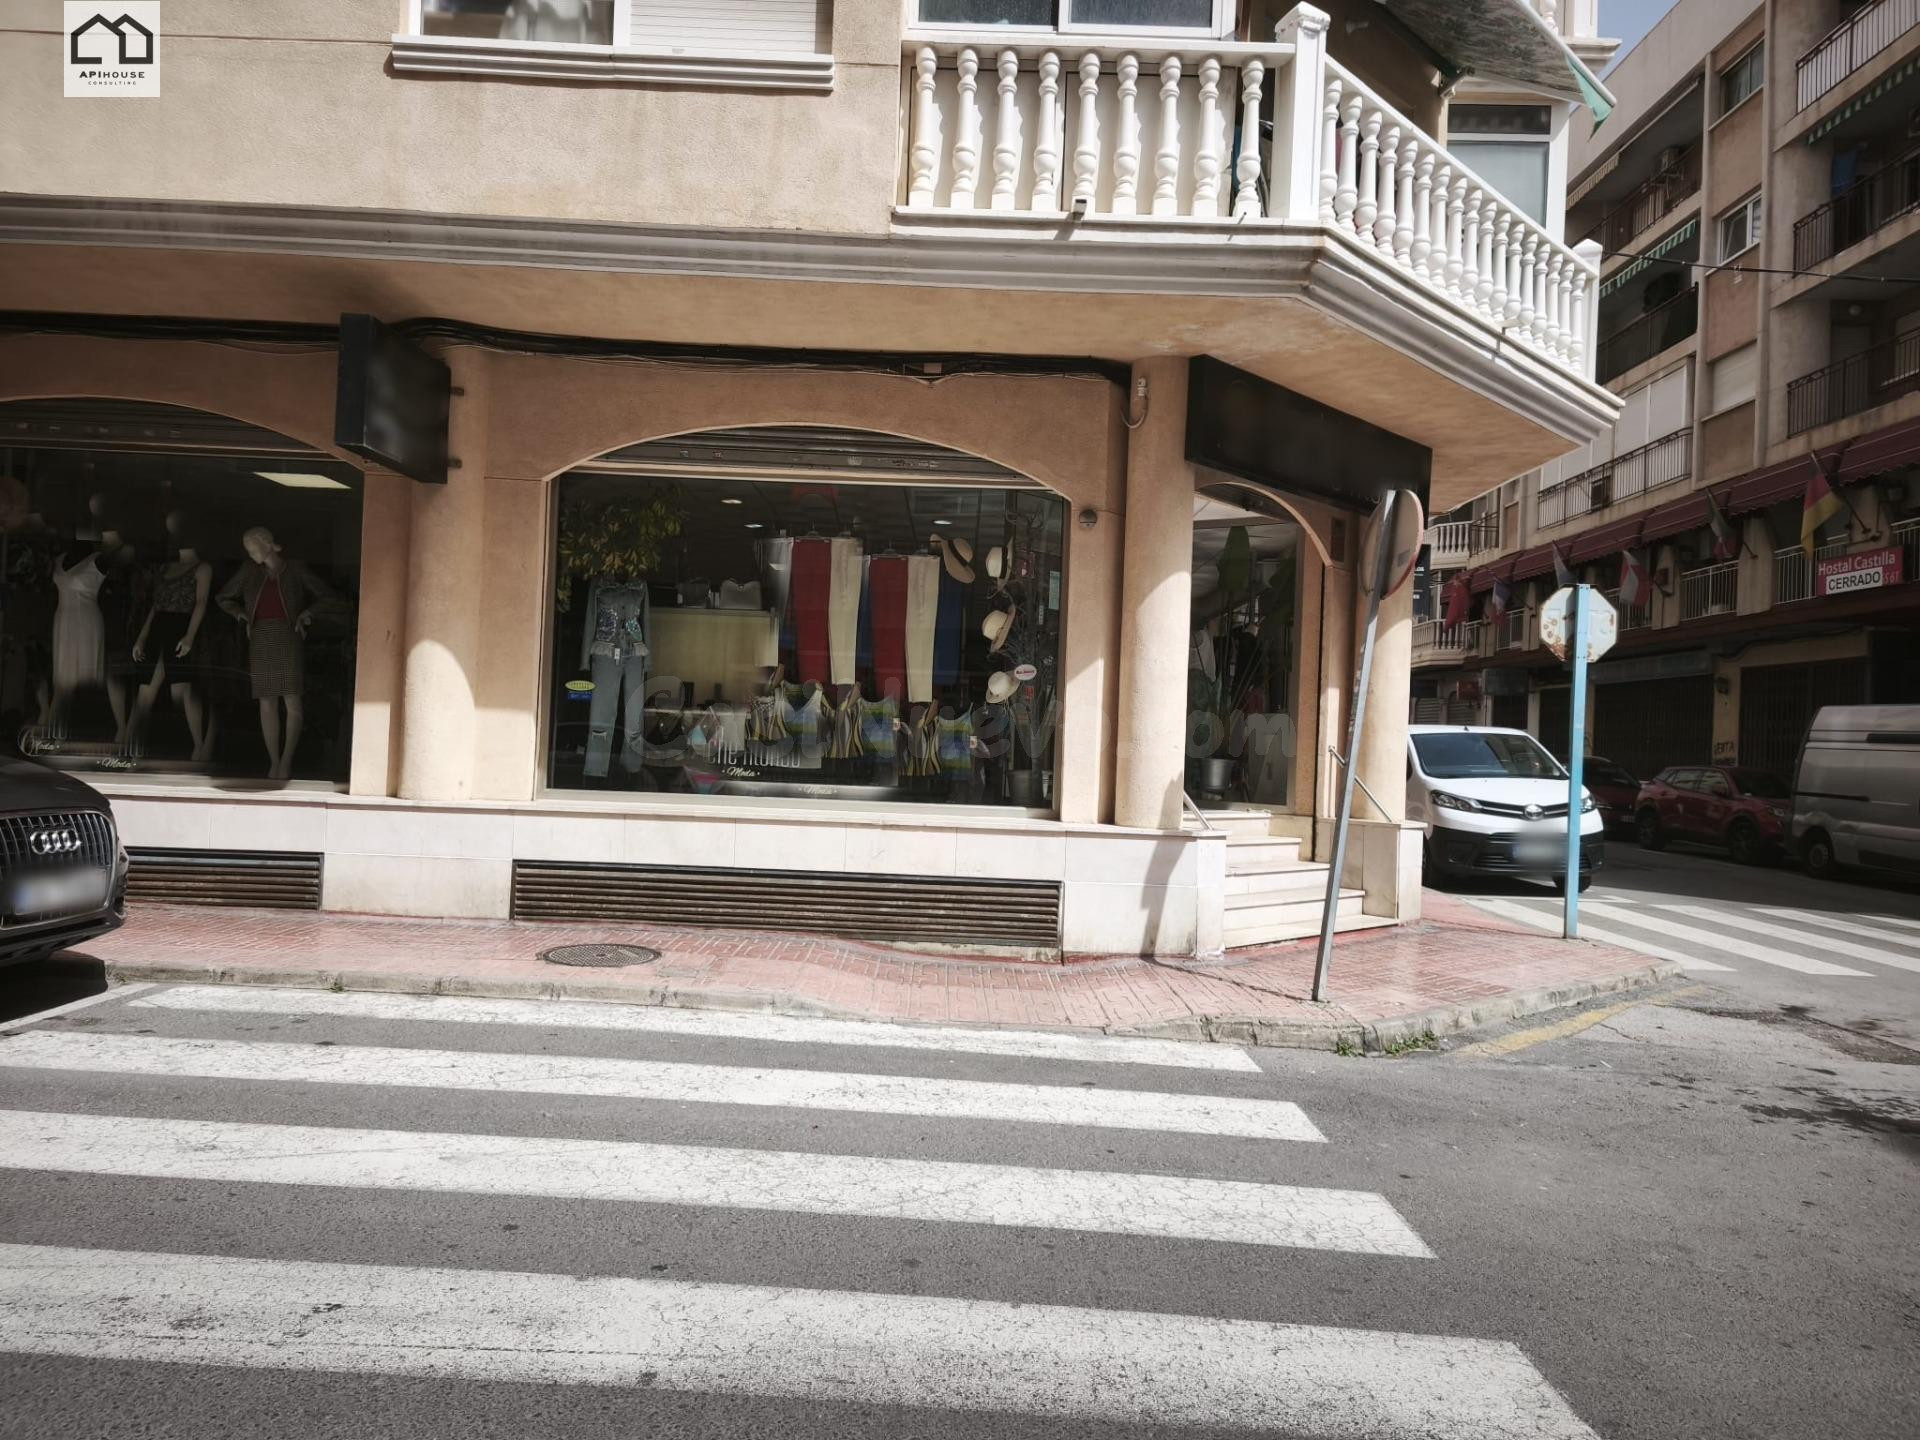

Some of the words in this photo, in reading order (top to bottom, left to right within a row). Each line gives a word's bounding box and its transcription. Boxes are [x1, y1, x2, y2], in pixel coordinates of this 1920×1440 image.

[1818, 558, 1852, 576] Hostal
[1855, 551, 1895, 569] Castilla
[1828, 571, 1881, 591] CERRADO
[726, 766, 756, 777] Moda
